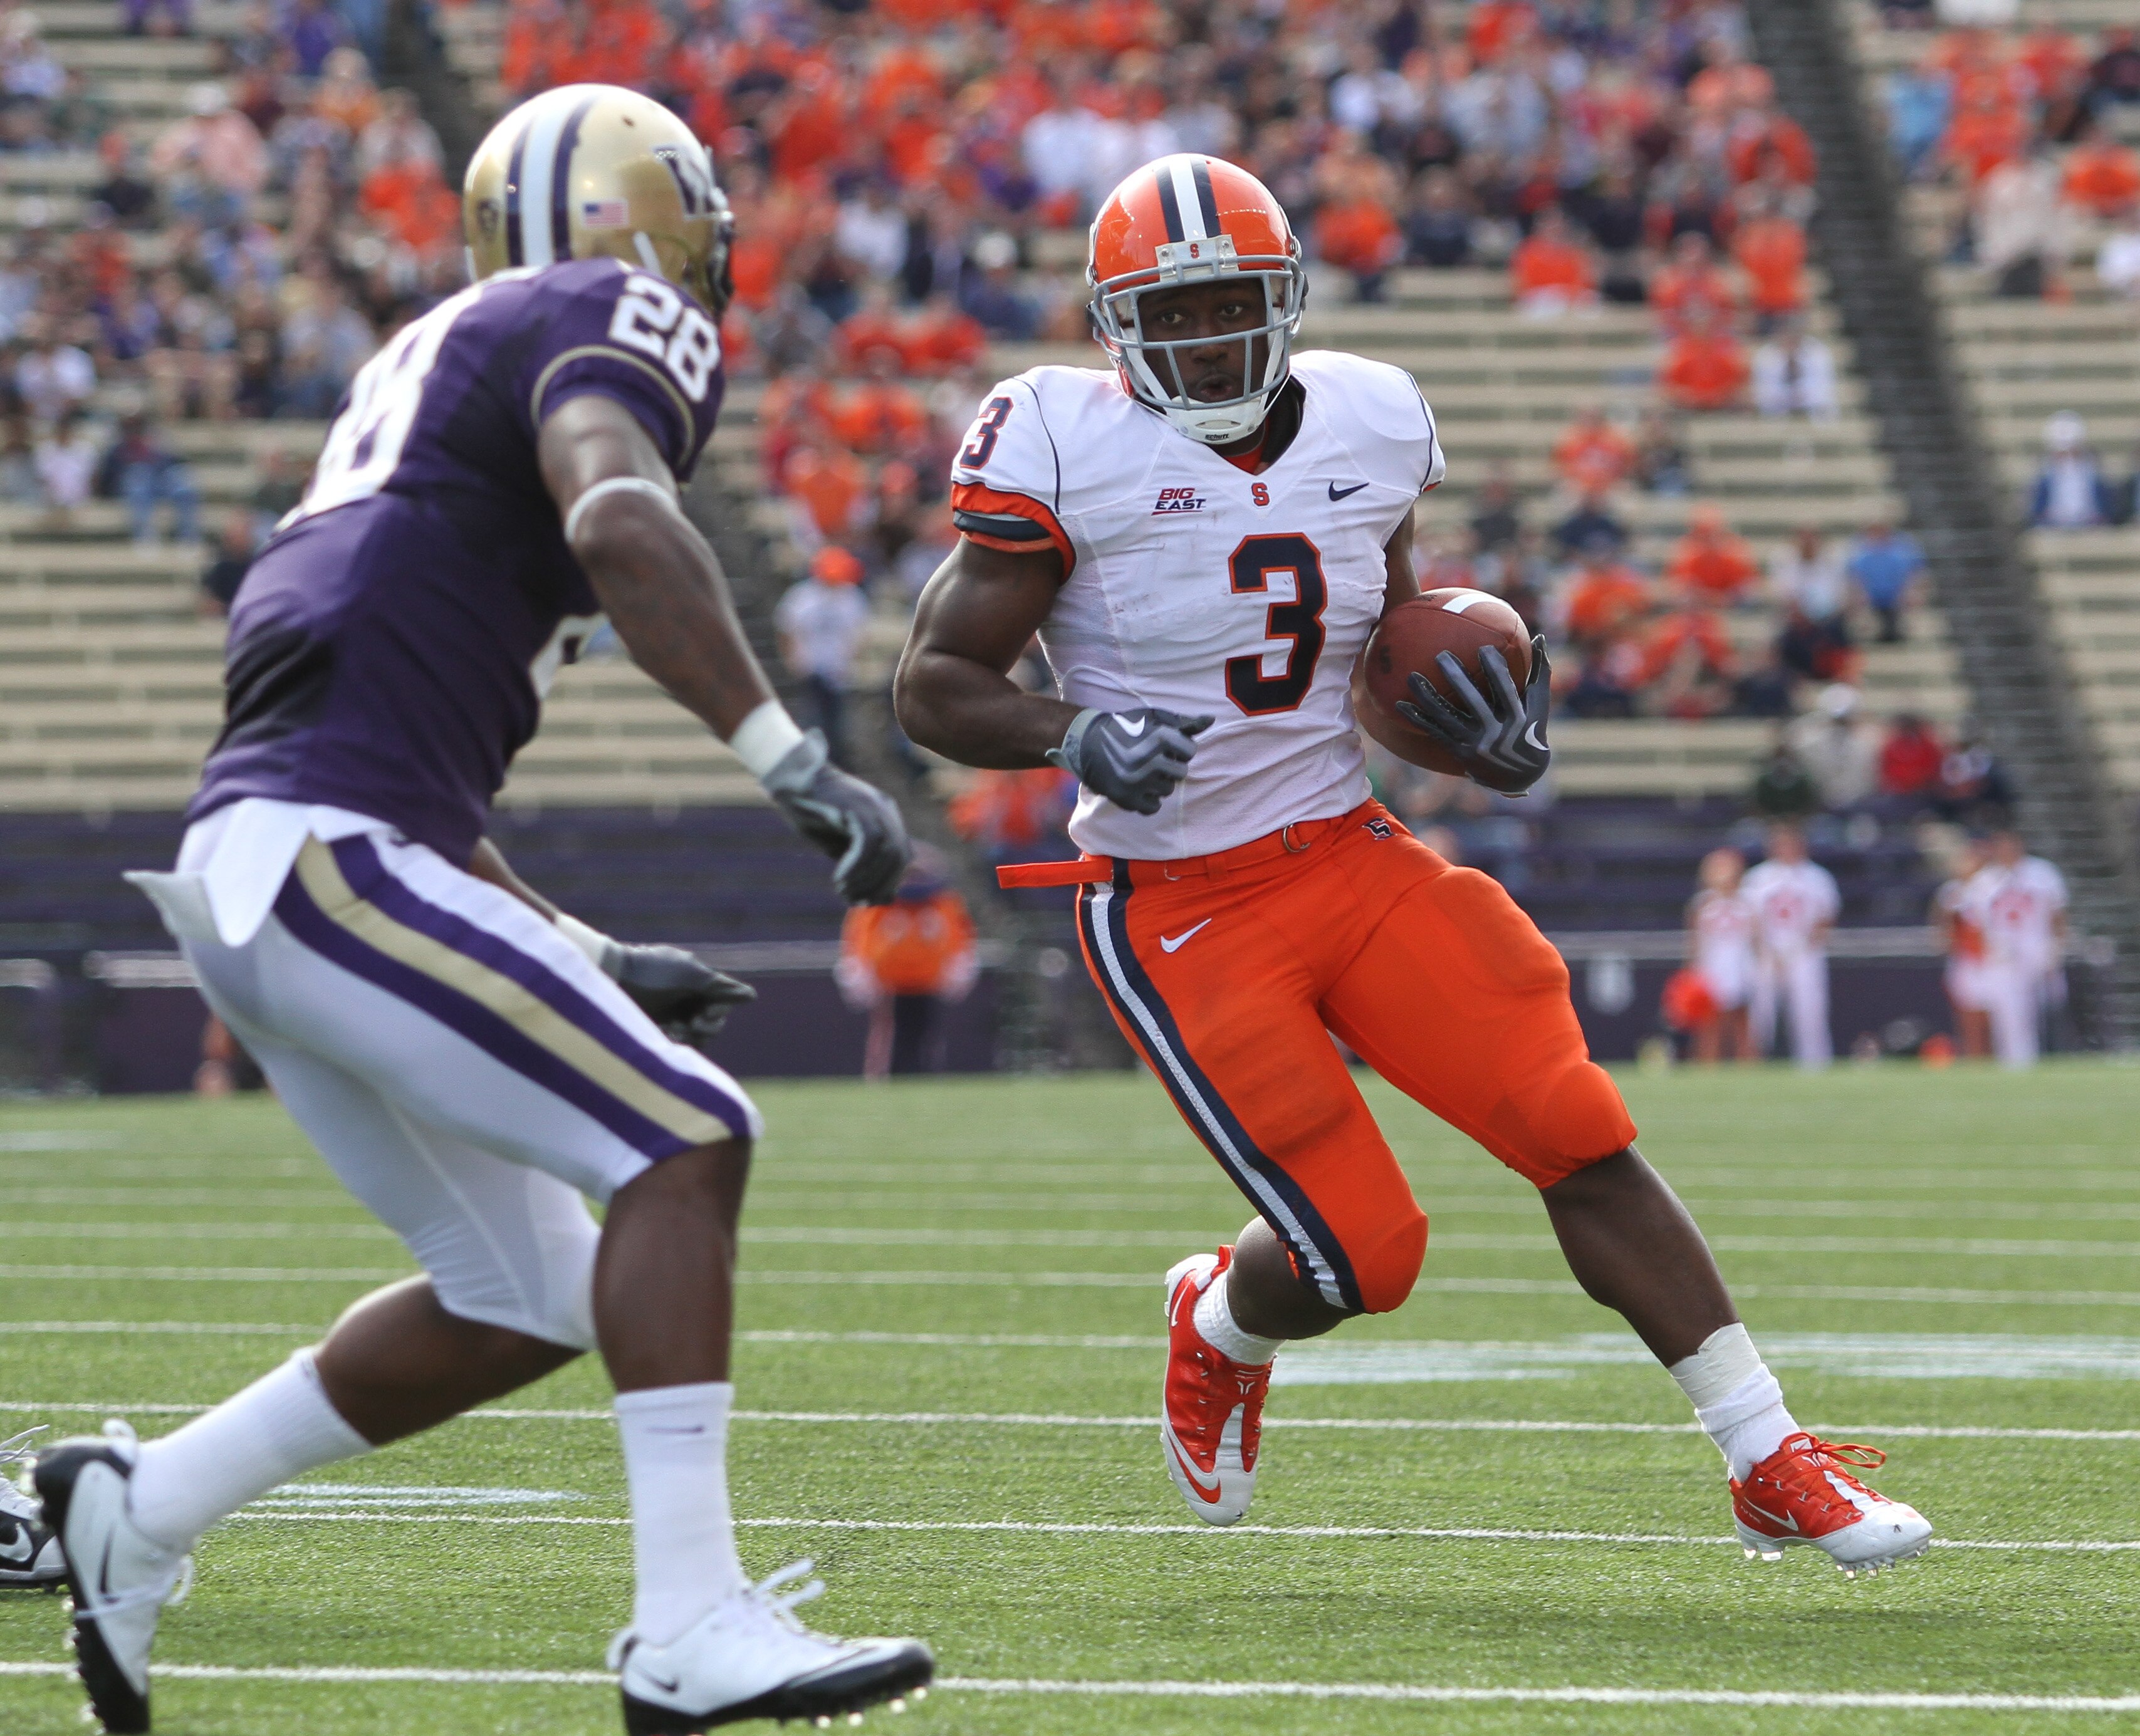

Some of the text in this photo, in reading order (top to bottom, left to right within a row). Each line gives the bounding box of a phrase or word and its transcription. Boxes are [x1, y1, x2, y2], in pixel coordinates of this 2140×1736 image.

[1190, 243, 1199, 259] S
[608, 274, 721, 403] 28
[959, 397, 1013, 470] 3
[1155, 499, 1206, 510] EAST
[1159, 487, 1195, 500] BIG
[1251, 482, 1270, 506] S
[1224, 533, 1328, 717] 3
